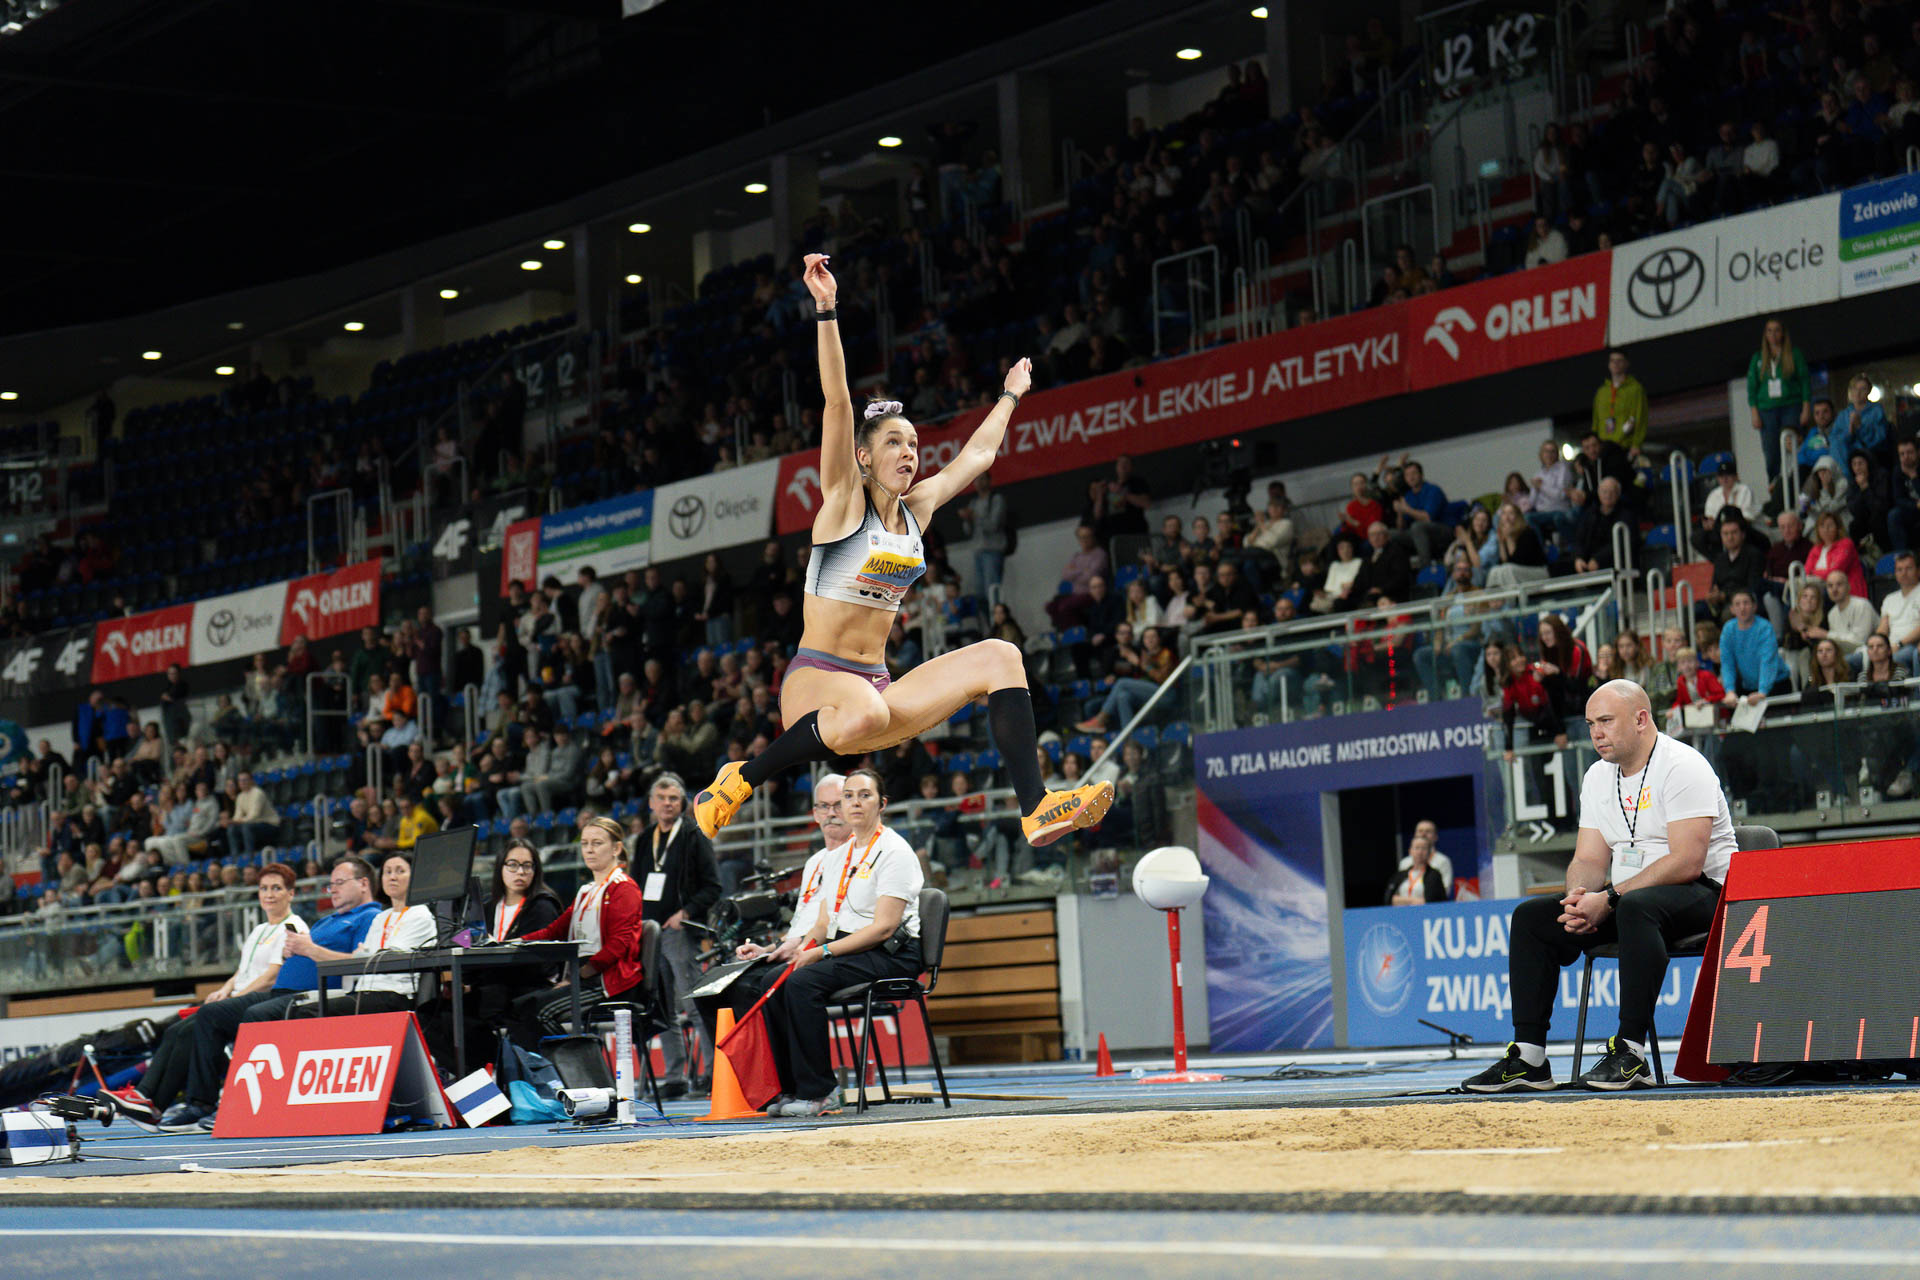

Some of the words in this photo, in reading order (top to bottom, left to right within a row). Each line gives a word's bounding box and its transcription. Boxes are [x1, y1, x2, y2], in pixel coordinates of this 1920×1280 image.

[1433, 34, 1474, 85] J2
[1487, 13, 1537, 68] K2
[1853, 192, 1918, 223] Zdrowie
[1728, 239, 1824, 283] Okęcie
[1484, 283, 1596, 341] ORLEN
[1016, 394, 1137, 452] ZWIĄZEK
[1143, 368, 1254, 424] LEKKIEJ
[1262, 333, 1399, 395] ATLETYKI
[432, 518, 471, 560] 4F
[319, 580, 373, 615] ORLEN
[55, 637, 89, 675] 4F
[131, 624, 186, 656] ORLEN
[2, 647, 43, 683] 4F
[1206, 757, 1228, 778] 70.
[1231, 753, 1266, 776] PZLA
[1269, 745, 1331, 770] HALOWE
[1337, 732, 1441, 763] MISTRZOSTWA
[1512, 752, 1567, 821] L1
[1035, 796, 1081, 827] NITRO
[1423, 914, 1512, 960] KUJA
[1724, 905, 1771, 983] 4
[1427, 973, 1513, 1020] ZWIĄZ
[298, 1055, 383, 1097] ORLEN
